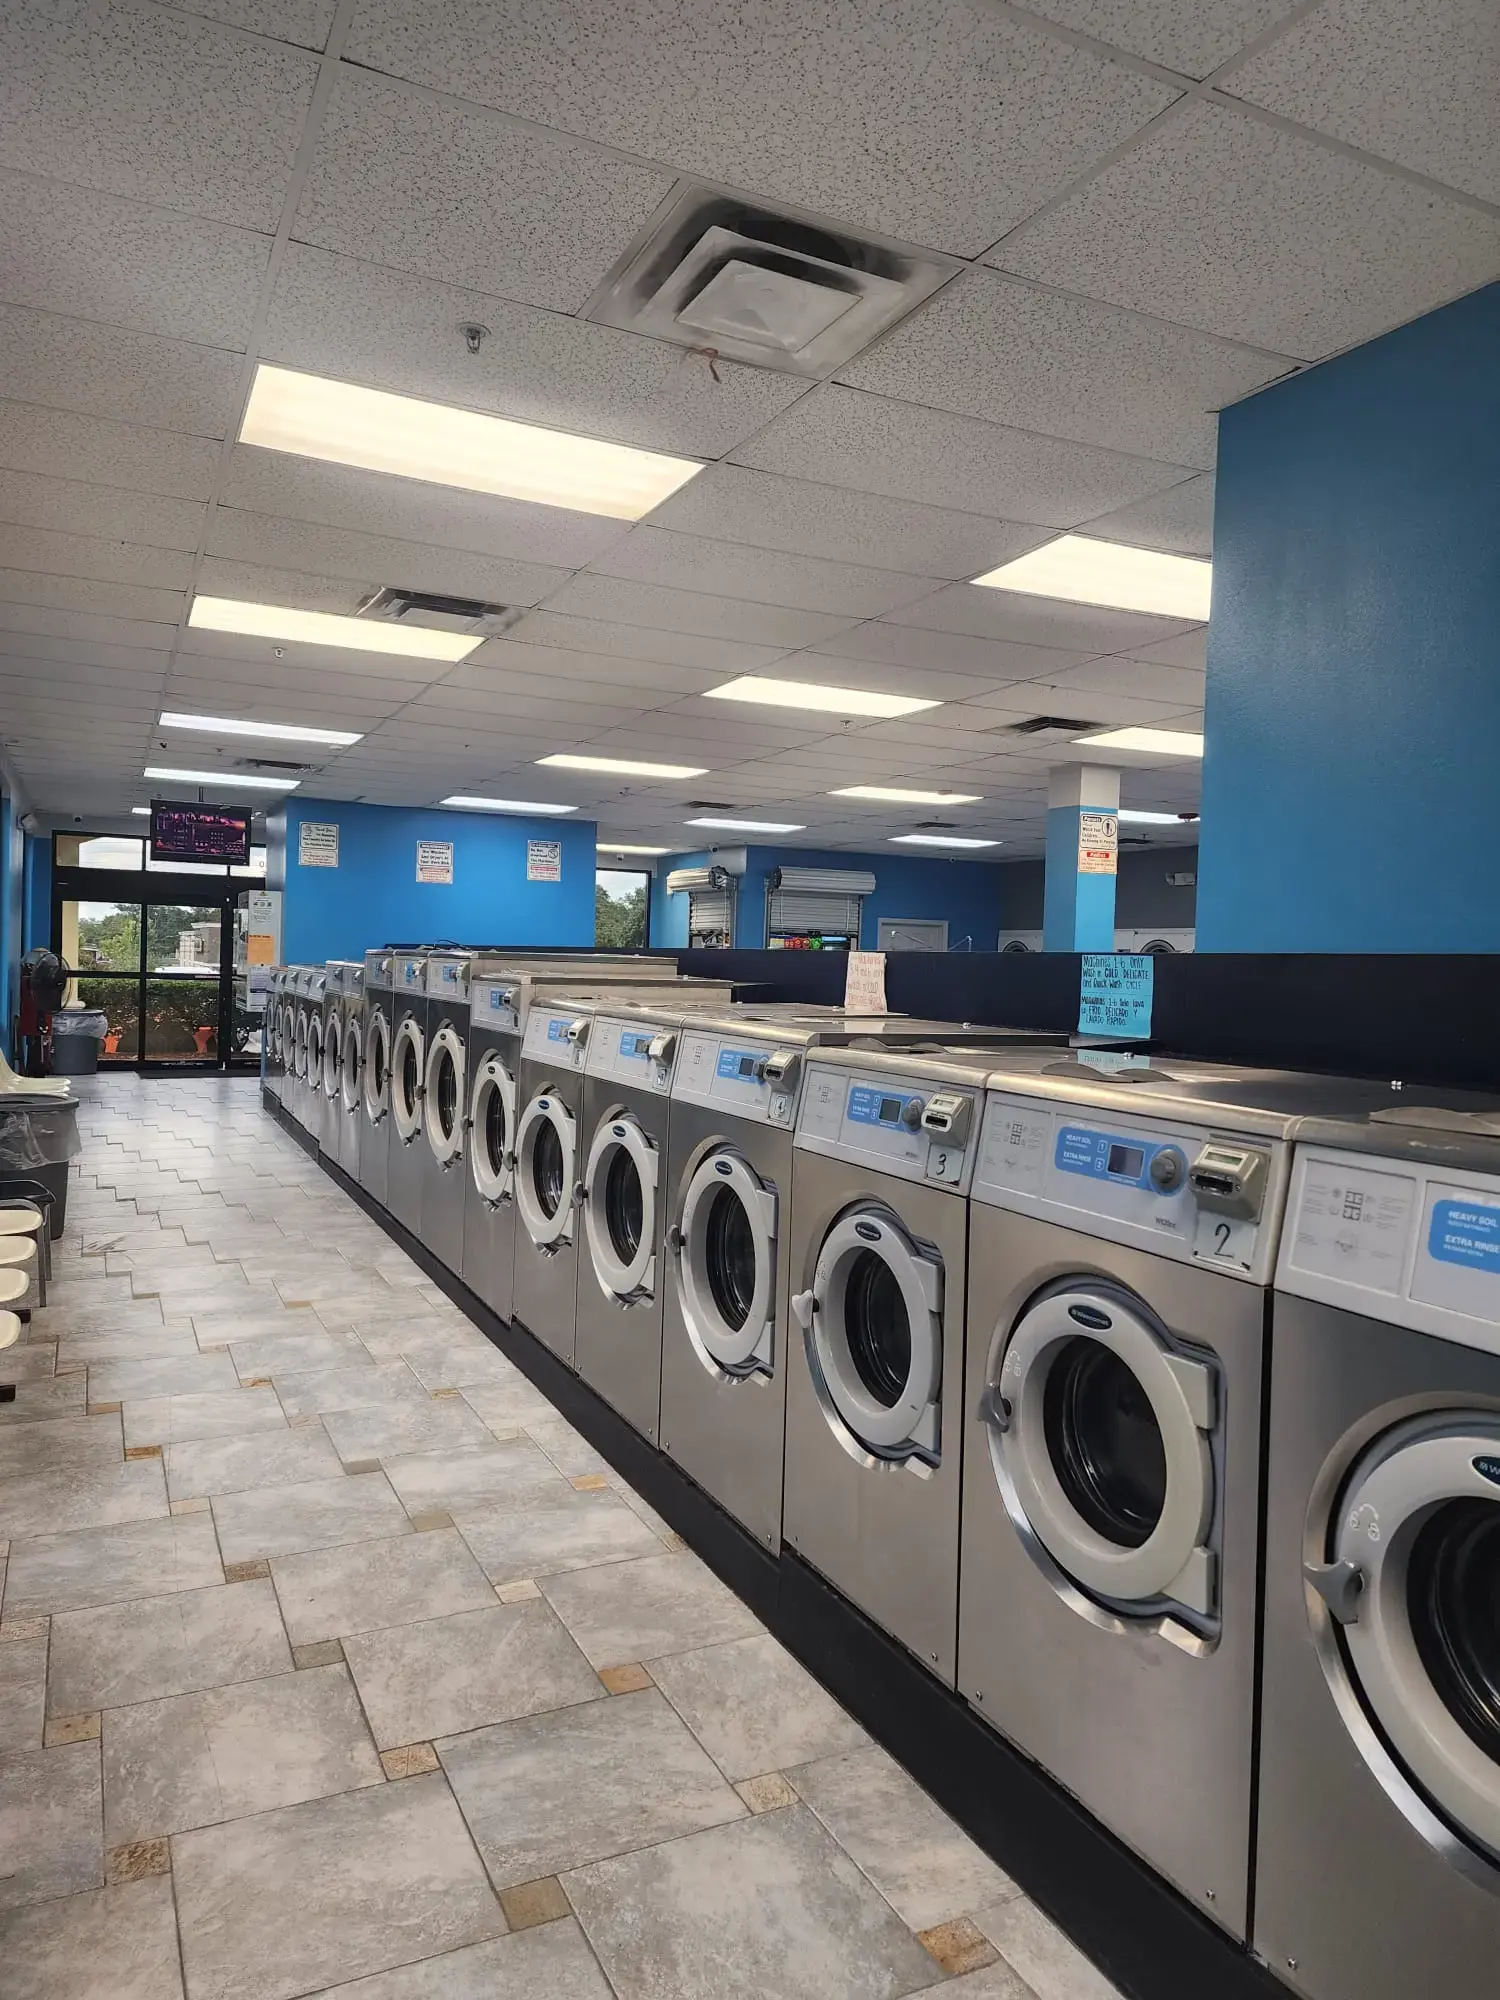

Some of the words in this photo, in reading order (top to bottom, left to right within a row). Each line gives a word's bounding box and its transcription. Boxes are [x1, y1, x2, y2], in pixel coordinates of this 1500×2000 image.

[935, 1153, 947, 1176] 3
[1448, 1210, 1478, 1223] HEAVY
[1478, 1216, 1498, 1228] SOIL
[1214, 1222, 1236, 1259] 2
[1444, 1234, 1473, 1248] EXTRA
[1474, 1240, 1500, 1254] RINSE
